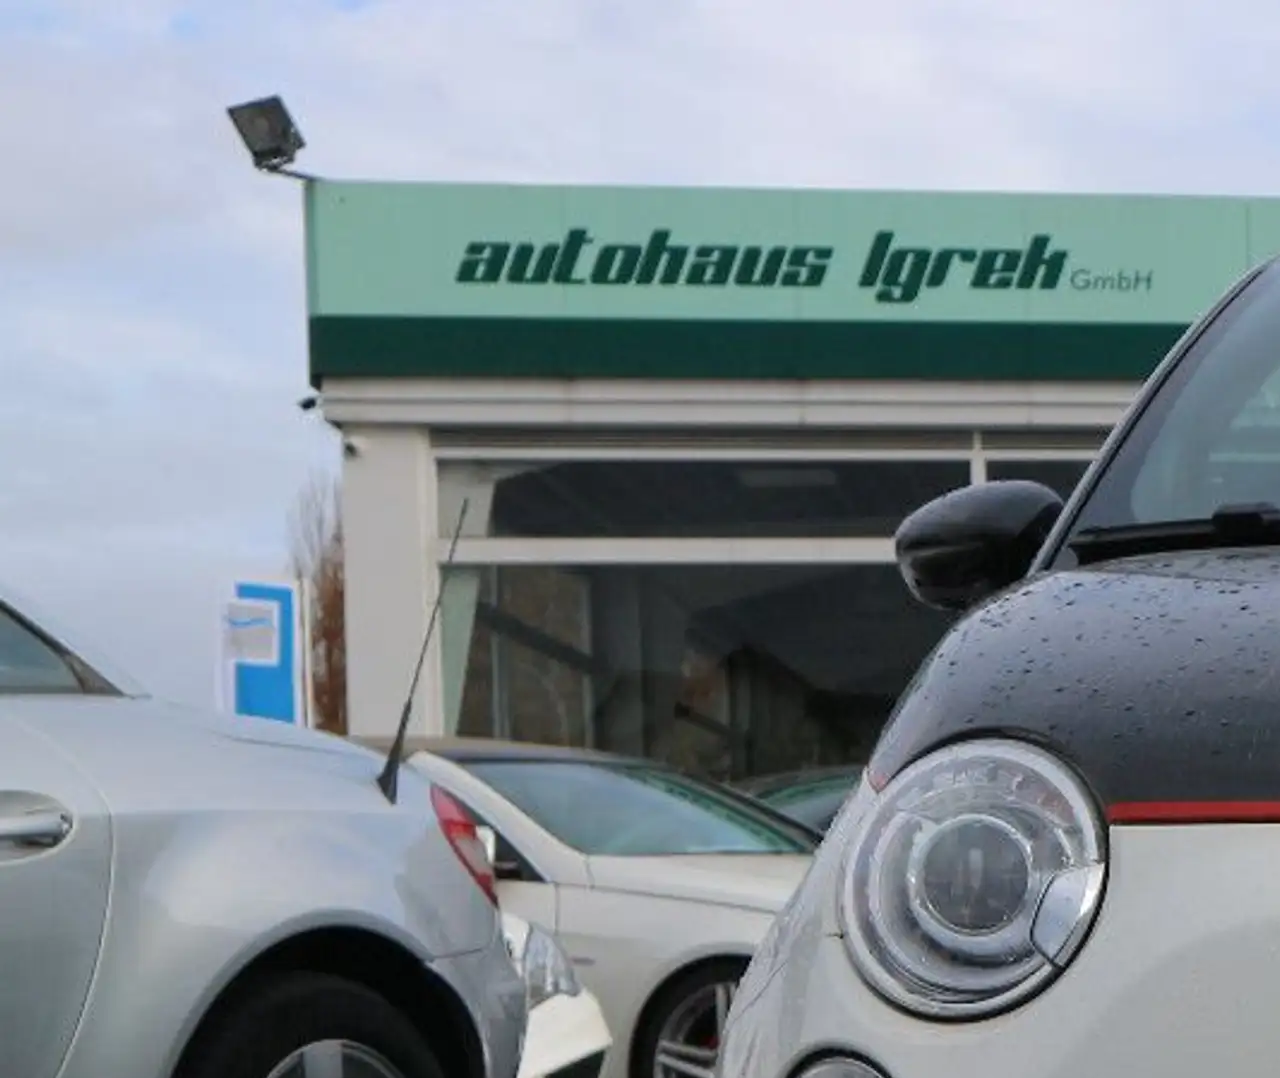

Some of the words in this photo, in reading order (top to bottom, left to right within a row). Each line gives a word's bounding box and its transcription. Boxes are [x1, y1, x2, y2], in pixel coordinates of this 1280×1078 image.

[455, 228, 834, 287] autohaus
[858, 230, 1069, 303] Igrek
[1069, 269, 1153, 292] GmbH
